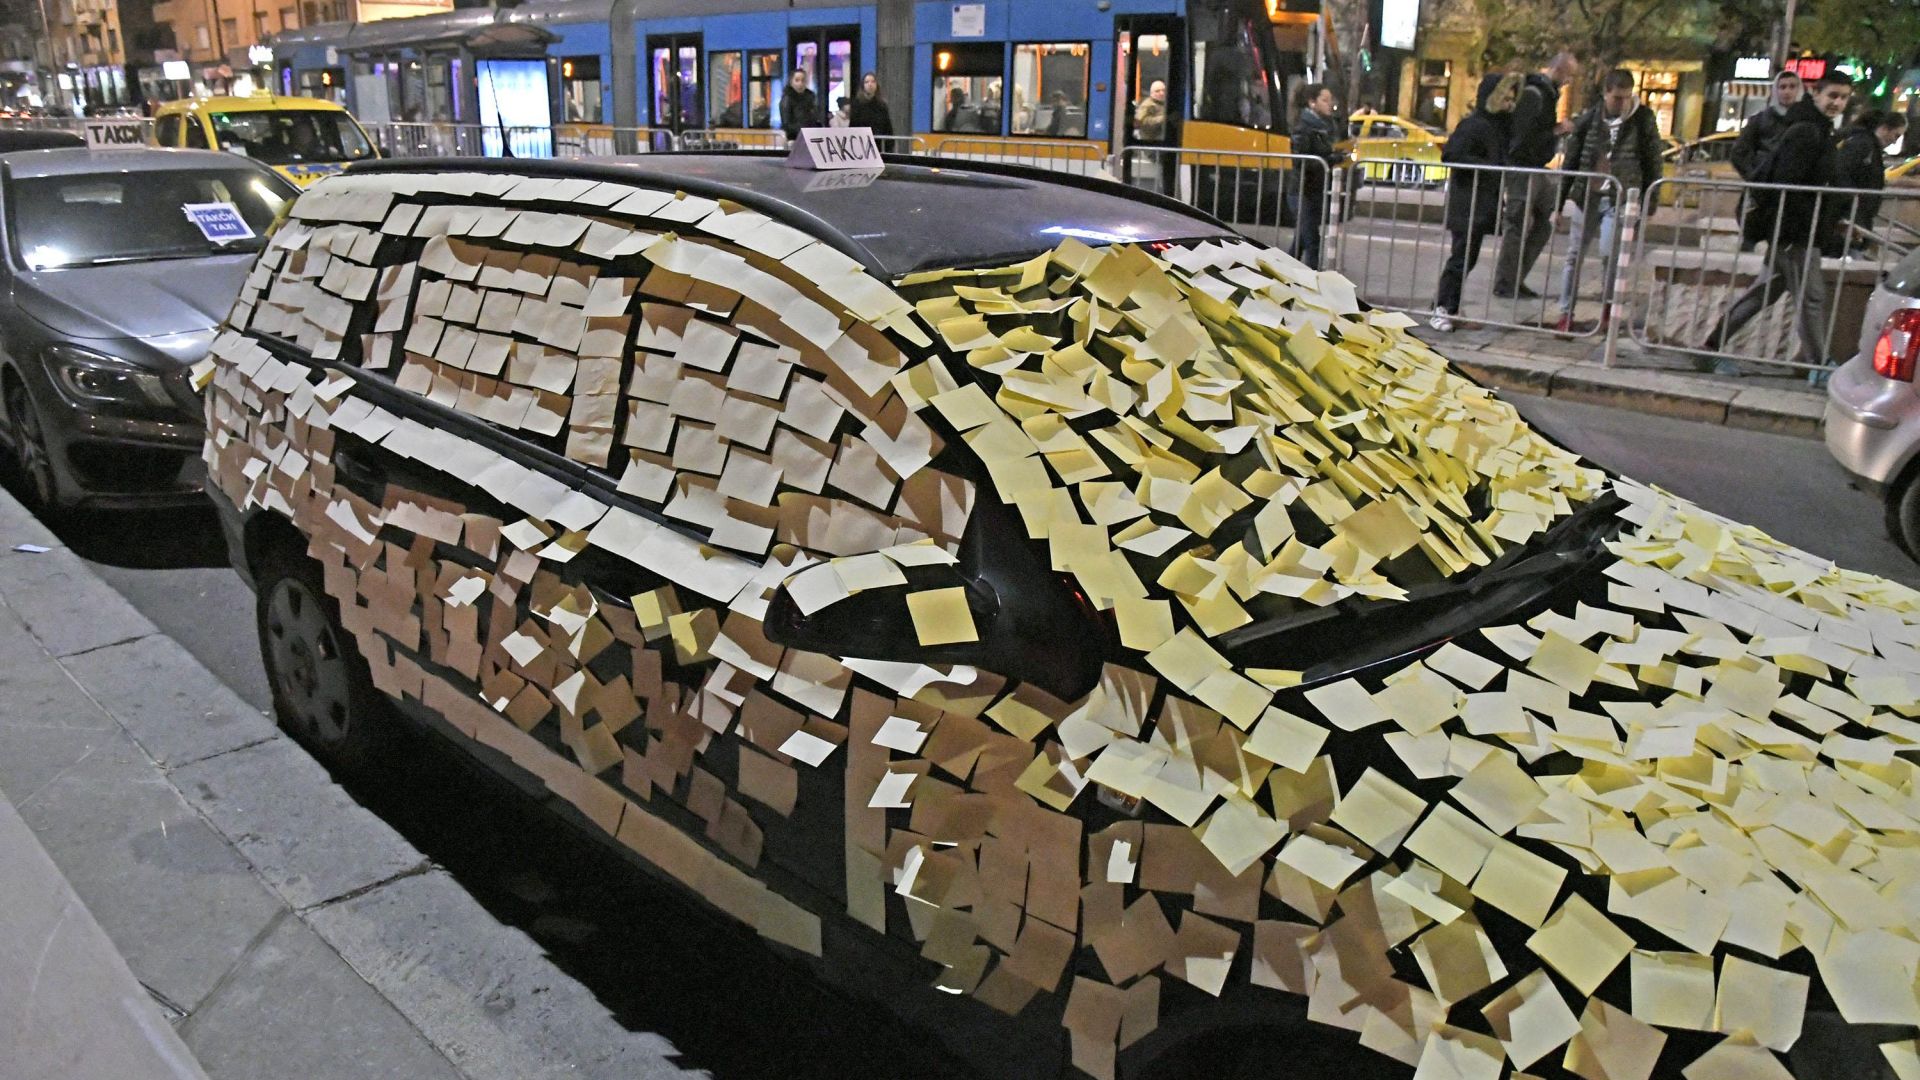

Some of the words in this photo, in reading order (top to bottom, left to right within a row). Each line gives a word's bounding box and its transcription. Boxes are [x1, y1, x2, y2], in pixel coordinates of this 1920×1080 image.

[88, 125, 144, 144] ТАКСИ
[810, 134, 877, 163] ТАКСИ
[196, 213, 237, 222] ТАКСИ
[211, 223, 239, 231] TAXI
